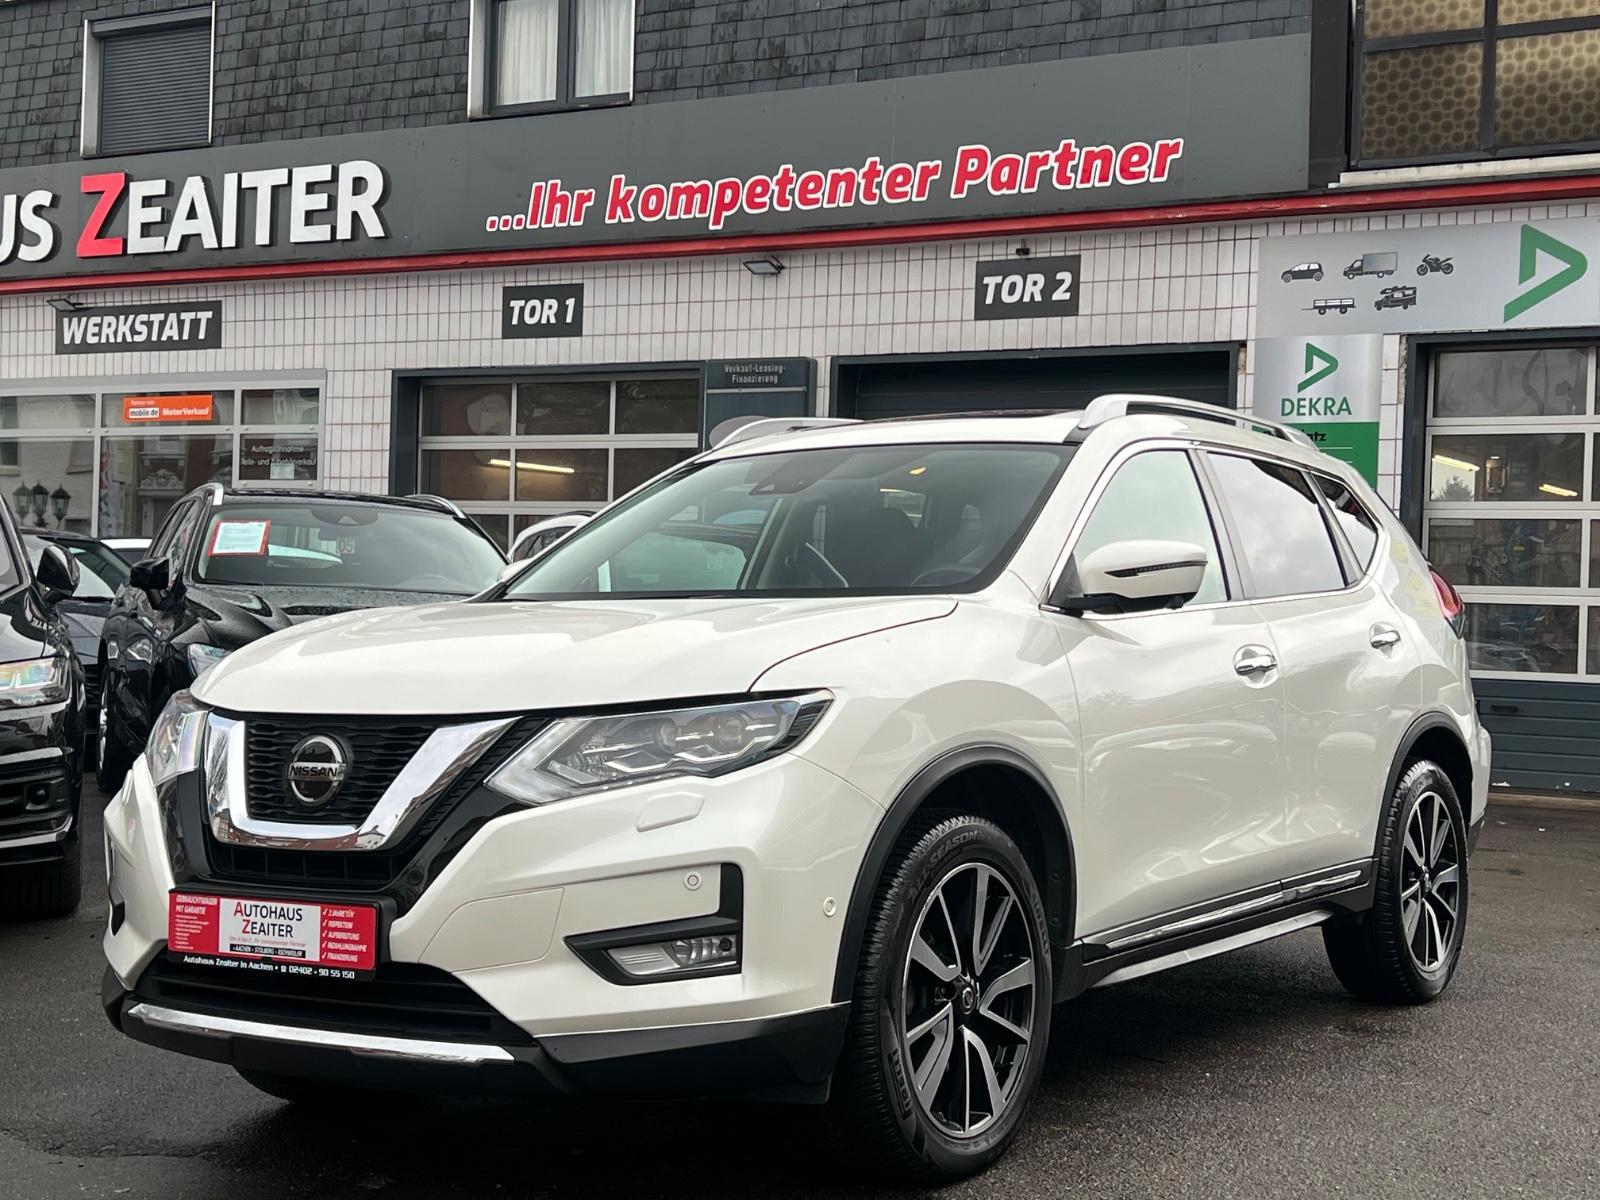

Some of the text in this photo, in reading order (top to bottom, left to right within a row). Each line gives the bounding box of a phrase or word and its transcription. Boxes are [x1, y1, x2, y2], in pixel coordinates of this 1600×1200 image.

[605, 157, 943, 230] kompetenter
[950, 138, 1184, 199] Partner
[76, 160, 386, 257] ZEAITER
[982, 271, 1074, 304] TOR 2
[510, 298, 576, 325] TOR 1
[62, 310, 214, 345] WERKSTATT
[732, 374, 779, 384] Finanzierung
[130, 407, 209, 417] mobile.de MotorVerkauf
[1280, 396, 1352, 417] DEKRA
[258, 457, 270, 466] und
[290, 765, 338, 777] NISSAN
[929, 829, 979, 864] SEASON
[234, 901, 303, 921] AUTOHAUS
[242, 919, 293, 938] ZEAITER
[183, 955, 214, 966] Autohaus
[216, 958, 239, 968] Zeaiter
[240, 960, 248, 968] in
[248, 961, 273, 971] Aachen
[289, 965, 313, 975] 02402
[319, 968, 329, 977] 90
[330, 969, 340, 978] 55
[342, 970, 355, 979] 150
